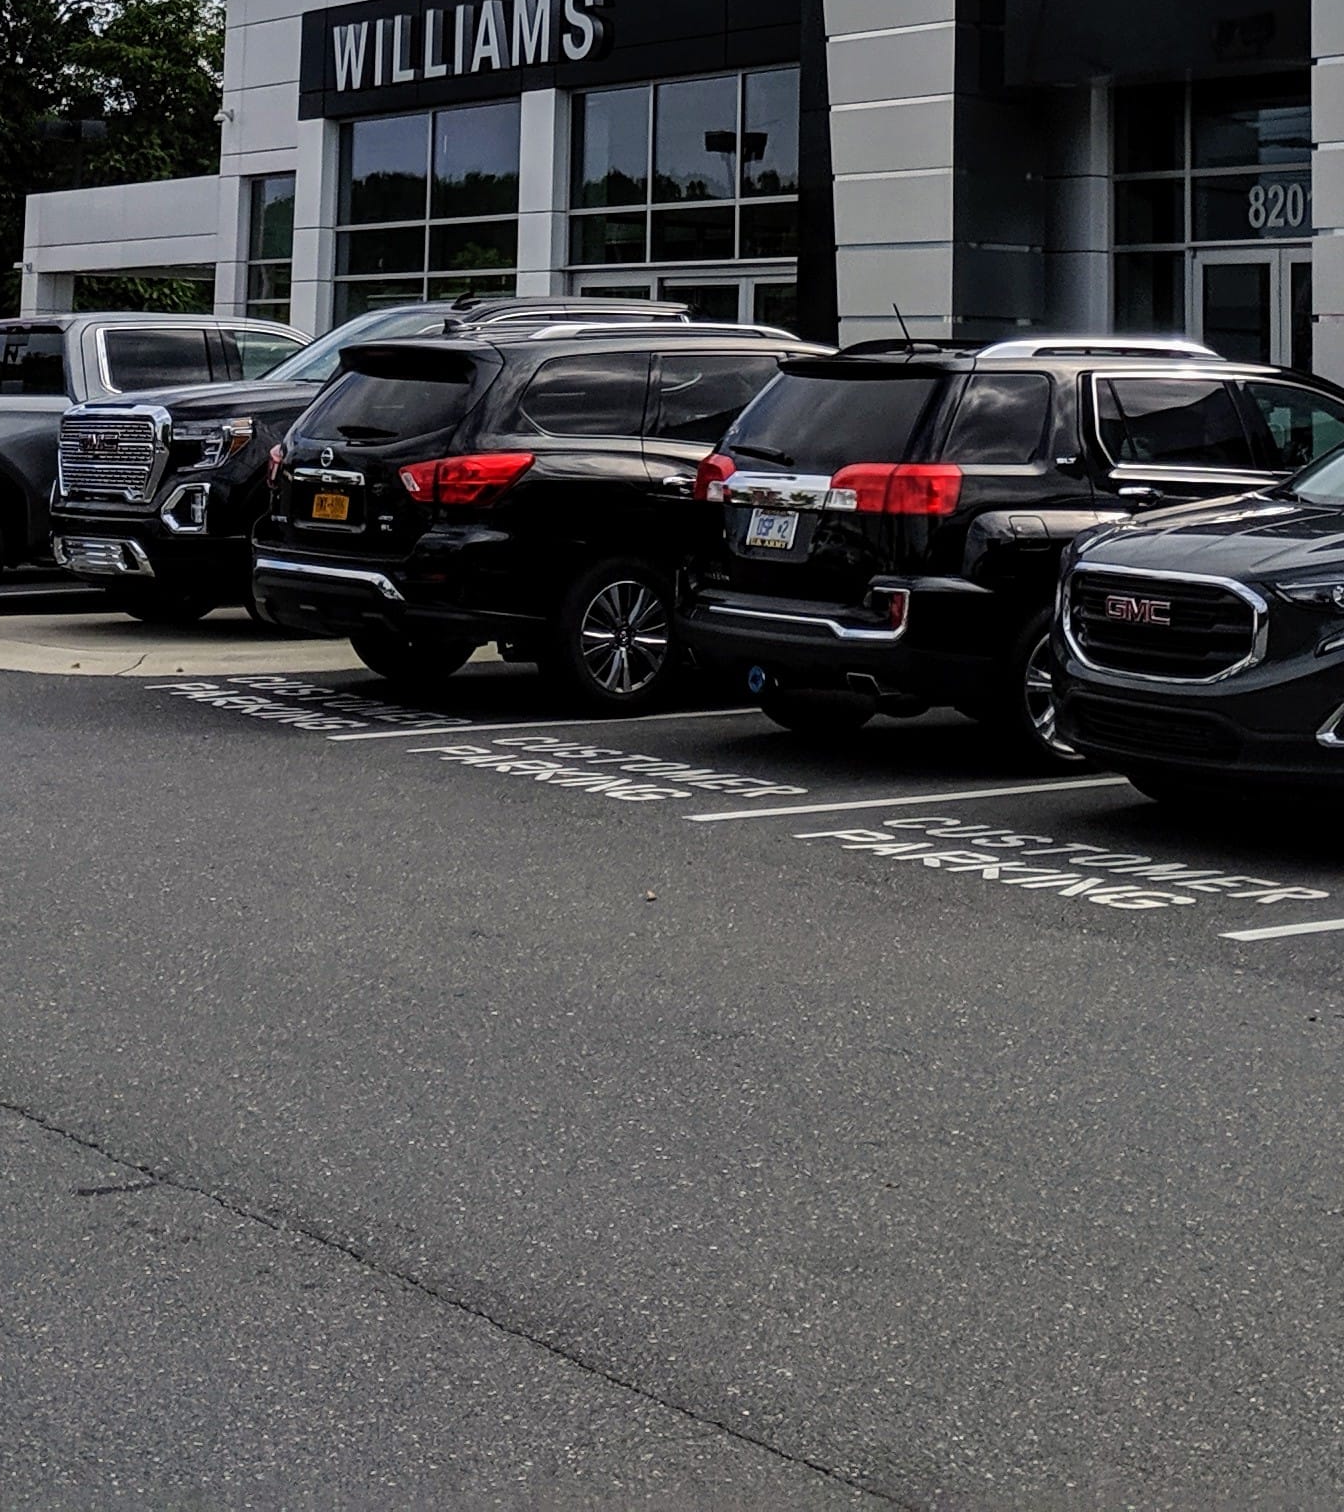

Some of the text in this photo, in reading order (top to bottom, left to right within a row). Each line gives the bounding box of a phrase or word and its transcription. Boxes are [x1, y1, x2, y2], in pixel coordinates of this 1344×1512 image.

[1248, 183, 1312, 229] 820
[1105, 595, 1171, 626] GMC
[144, 681, 369, 730] PARKING
[227, 675, 472, 727] CUSTOMER
[406, 744, 693, 802] PARKING
[491, 736, 809, 799] CUSTOMER
[792, 828, 1197, 910] PARKING
[883, 816, 1330, 905] CUSTOMER
